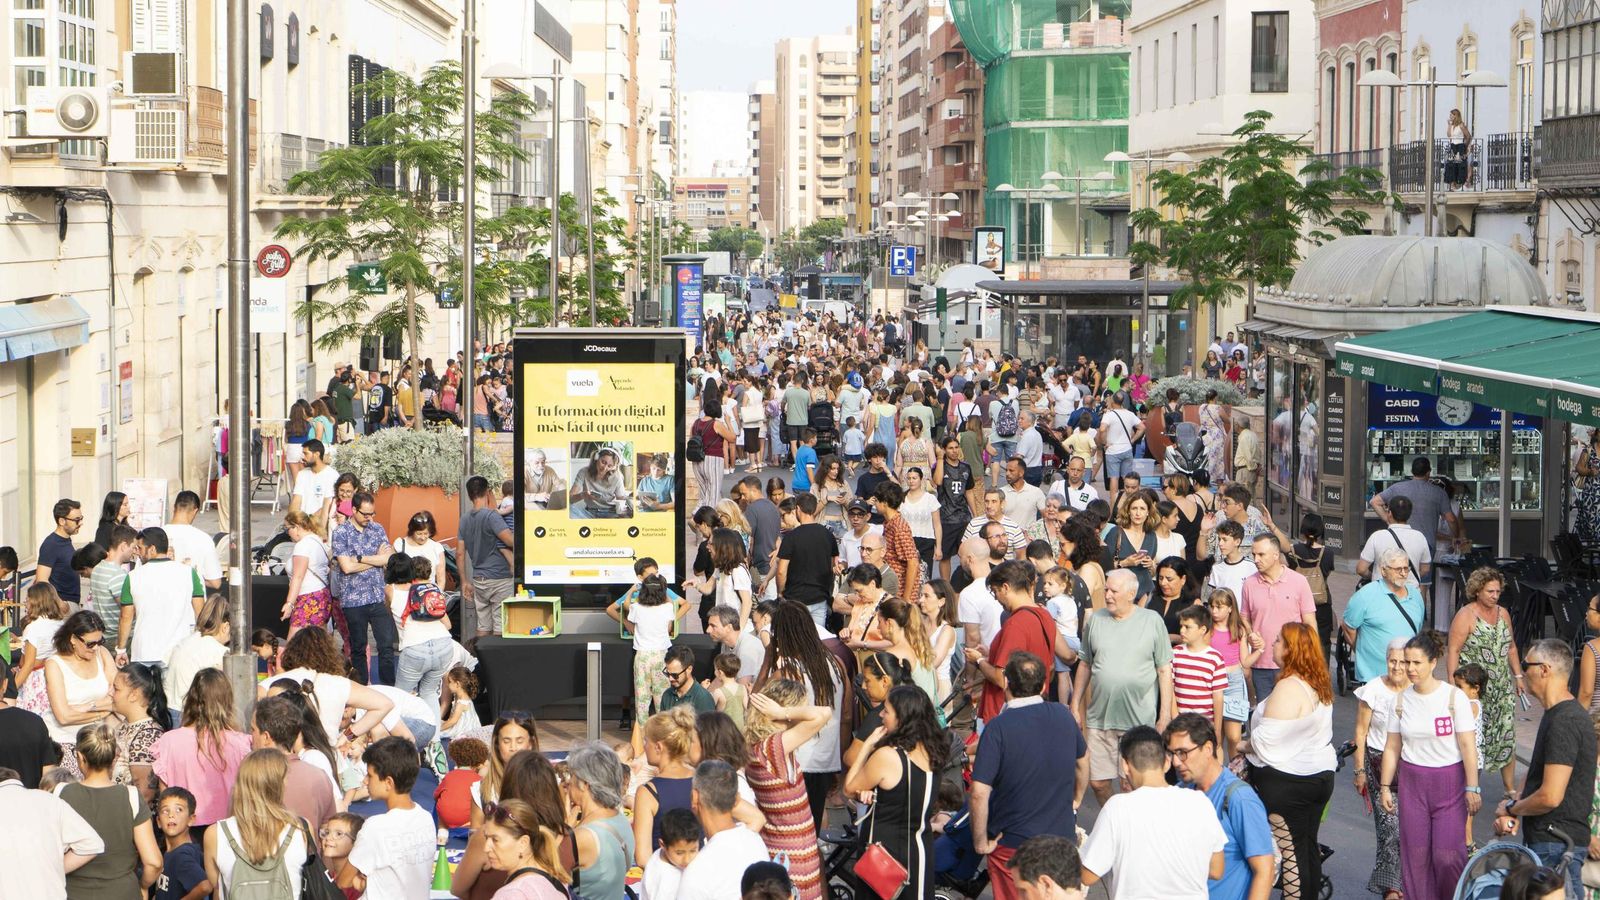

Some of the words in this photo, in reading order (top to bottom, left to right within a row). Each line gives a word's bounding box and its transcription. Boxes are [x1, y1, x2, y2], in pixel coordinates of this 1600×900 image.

[894, 248, 906, 266] P
[250, 297, 267, 306] nda
[1442, 376, 1460, 392] bodega
[1466, 382, 1484, 394] aranda
[536, 406, 550, 416] Tu
[554, 405, 622, 416] formación
[624, 405, 666, 418] digital
[1558, 396, 1582, 416] bodega
[1385, 414, 1420, 422] FESTINA
[538, 421, 564, 432] más
[568, 421, 594, 432] fácil
[597, 424, 622, 435] que
[624, 424, 664, 432] nunca
[1328, 492, 1340, 500] PILAS
